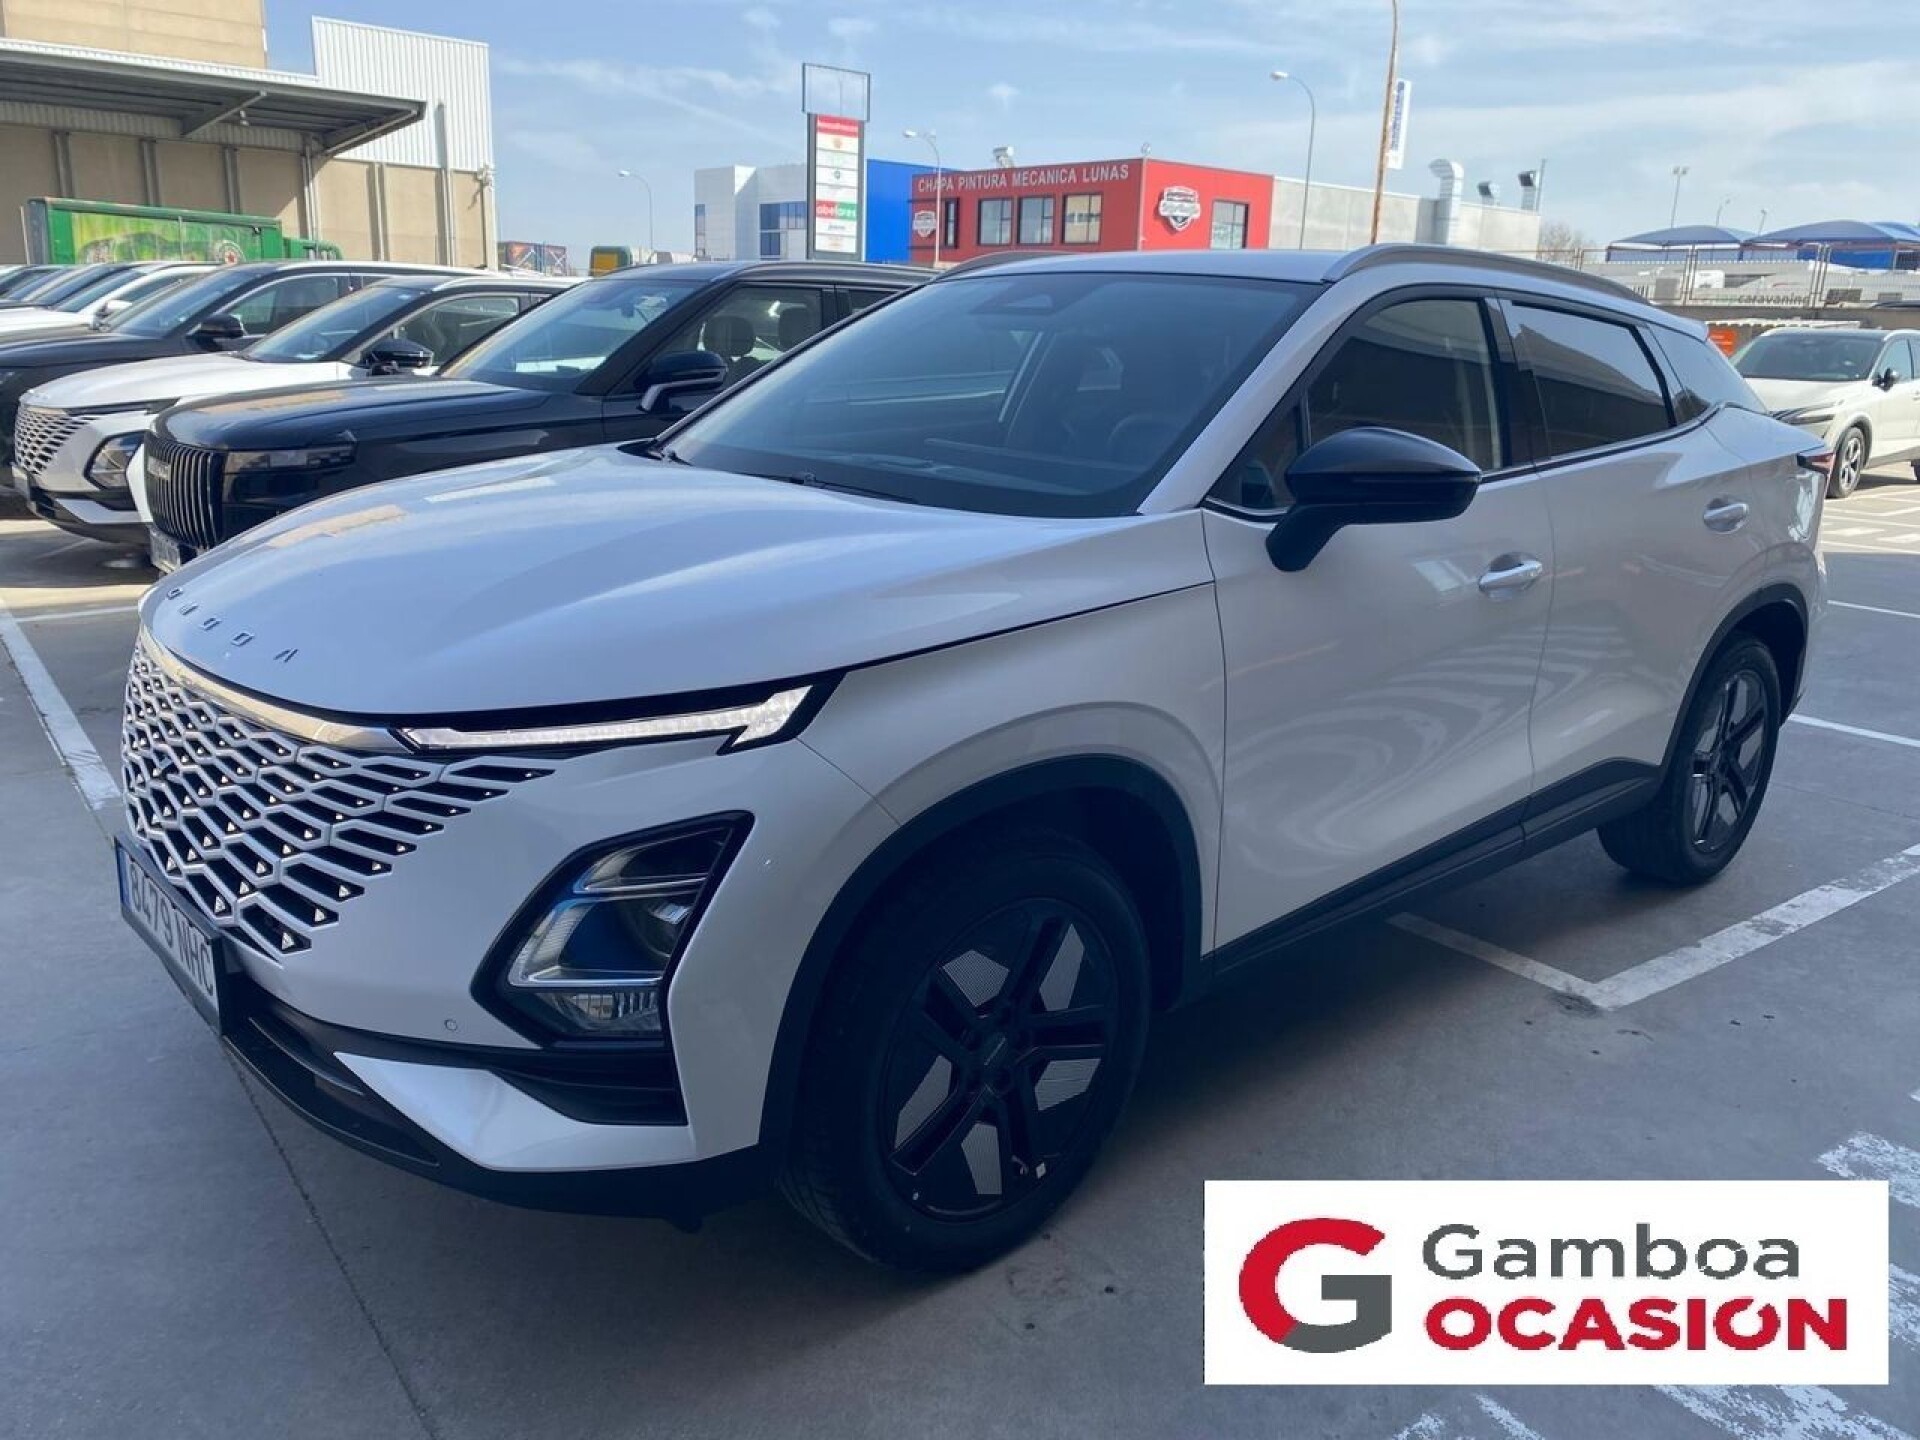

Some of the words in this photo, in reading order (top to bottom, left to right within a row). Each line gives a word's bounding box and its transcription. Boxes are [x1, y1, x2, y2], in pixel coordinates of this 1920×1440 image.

[918, 176, 955, 193] CHAPA
[958, 171, 1007, 190] PINTURA
[1012, 167, 1077, 188] MECANICA
[1082, 164, 1129, 183] LUNAS
[131, 861, 173, 949] 8479
[174, 911, 214, 997] NHC
